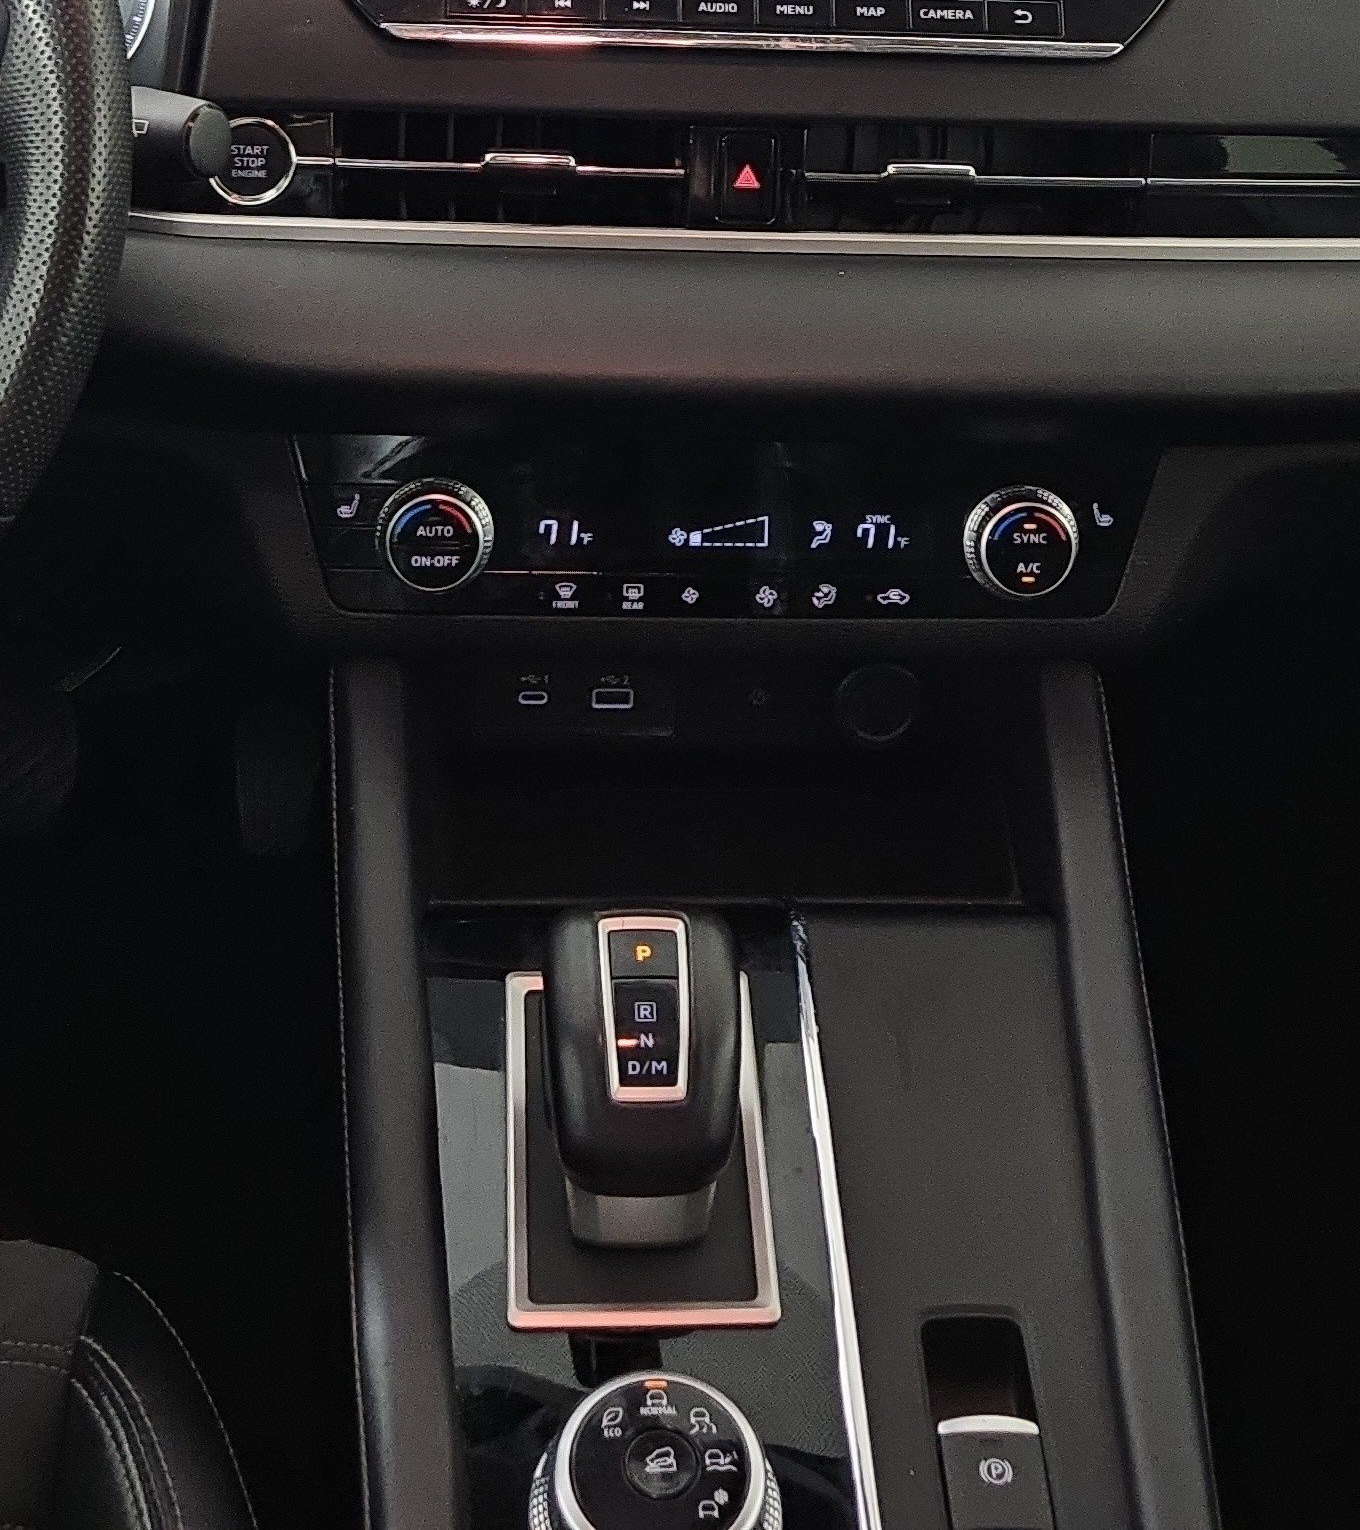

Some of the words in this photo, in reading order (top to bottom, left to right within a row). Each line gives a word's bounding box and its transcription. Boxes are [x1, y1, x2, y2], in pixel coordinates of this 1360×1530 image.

[697, 1, 738, 14] AUDIO
[775, 3, 815, 17] MENU
[855, 5, 886, 19] MAP
[919, 7, 974, 21] CAMERA
[230, 144, 269, 155] START
[234, 157, 266, 167] STOP
[231, 169, 268, 178] ENGINE
[864, 514, 892, 525] SYNC
[415, 525, 455, 538] AUTO
[1012, 532, 1048, 545] SYNC
[1016, 562, 1042, 574] A/C
[621, 601, 645, 610] REAR
[635, 945, 652, 962] P
[639, 1032, 655, 1048] N
[626, 1060, 668, 1076] D/M
[603, 1426, 623, 1438] ECO
